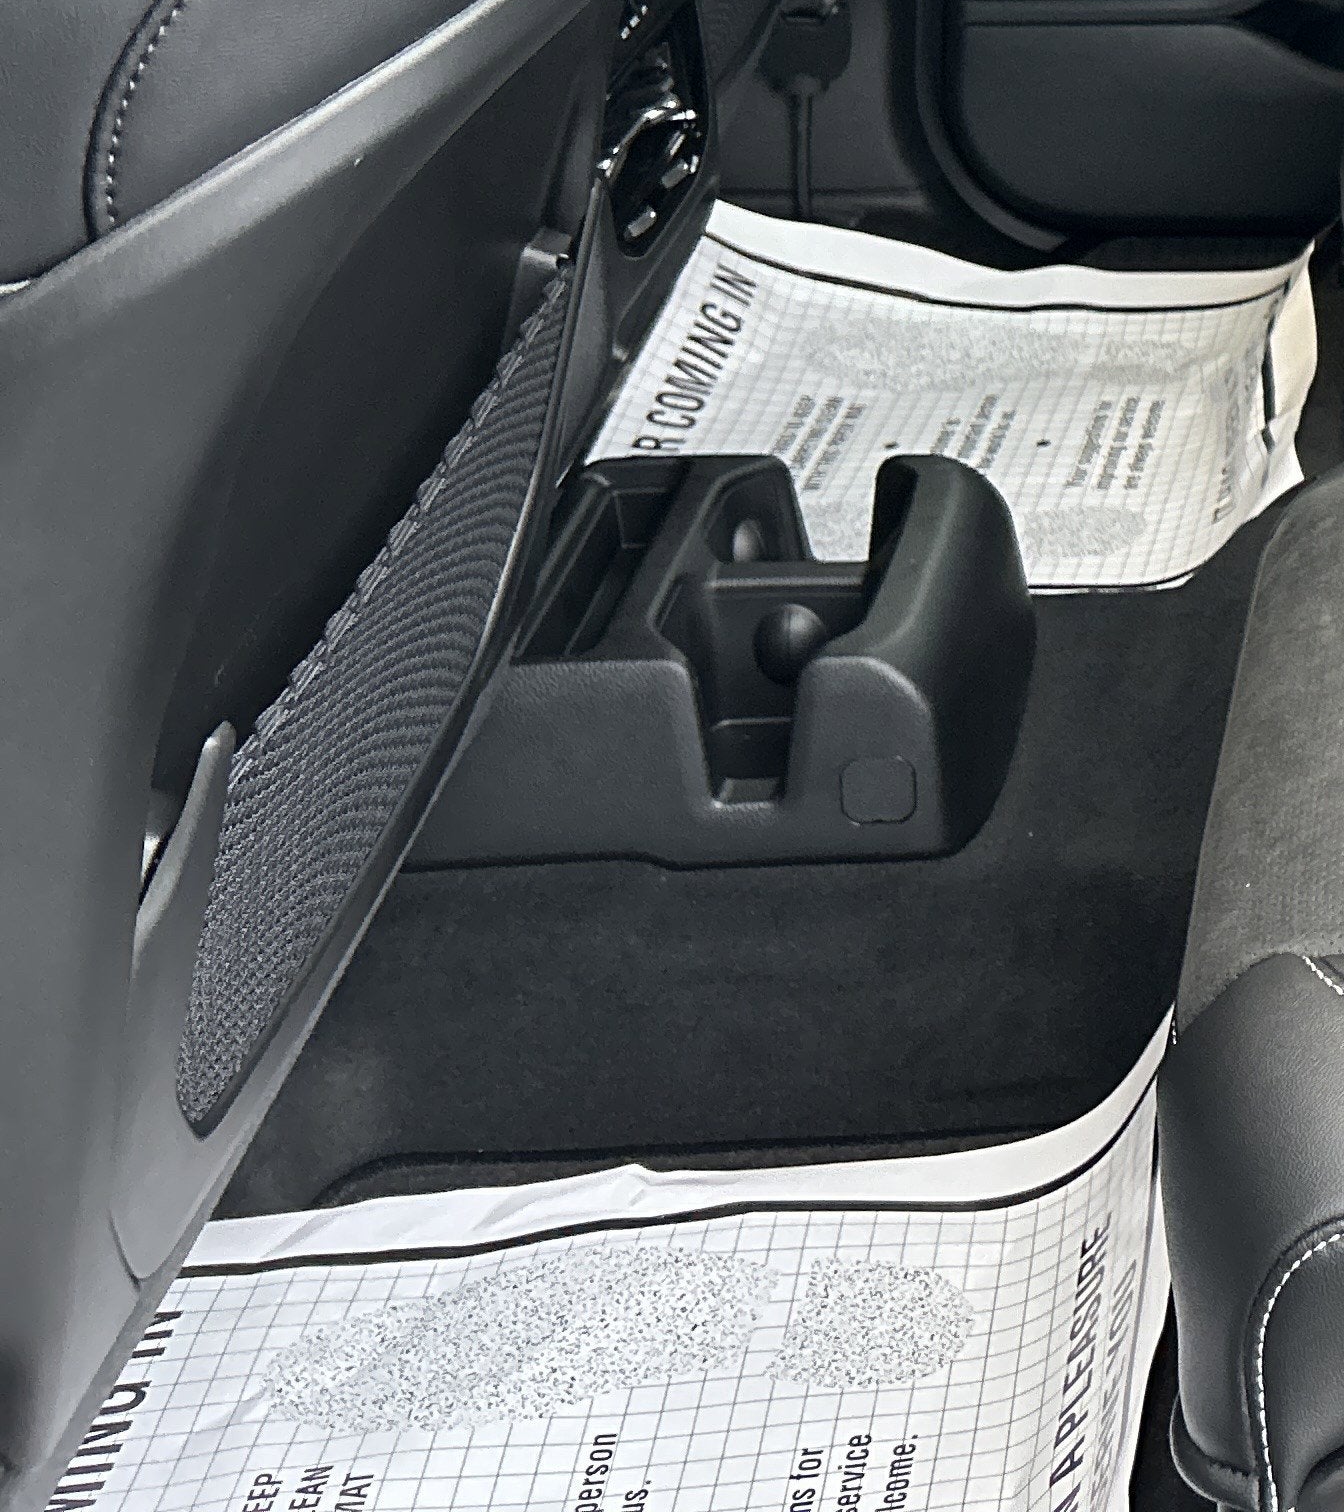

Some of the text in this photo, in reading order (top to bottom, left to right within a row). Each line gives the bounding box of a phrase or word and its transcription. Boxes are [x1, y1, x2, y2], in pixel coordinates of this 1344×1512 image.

[646, 301, 743, 429] COMING
[710, 262, 758, 307] IN
[1053, 1210, 1112, 1450] PLEASURE
[1105, 1258, 1137, 1375] YOU
[288, 1465, 334, 1512] EAN
[574, 1433, 617, 1512] person
[788, 1447, 824, 1480] for
[835, 1434, 872, 1512] service
[1049, 1433, 1085, 1488] A
